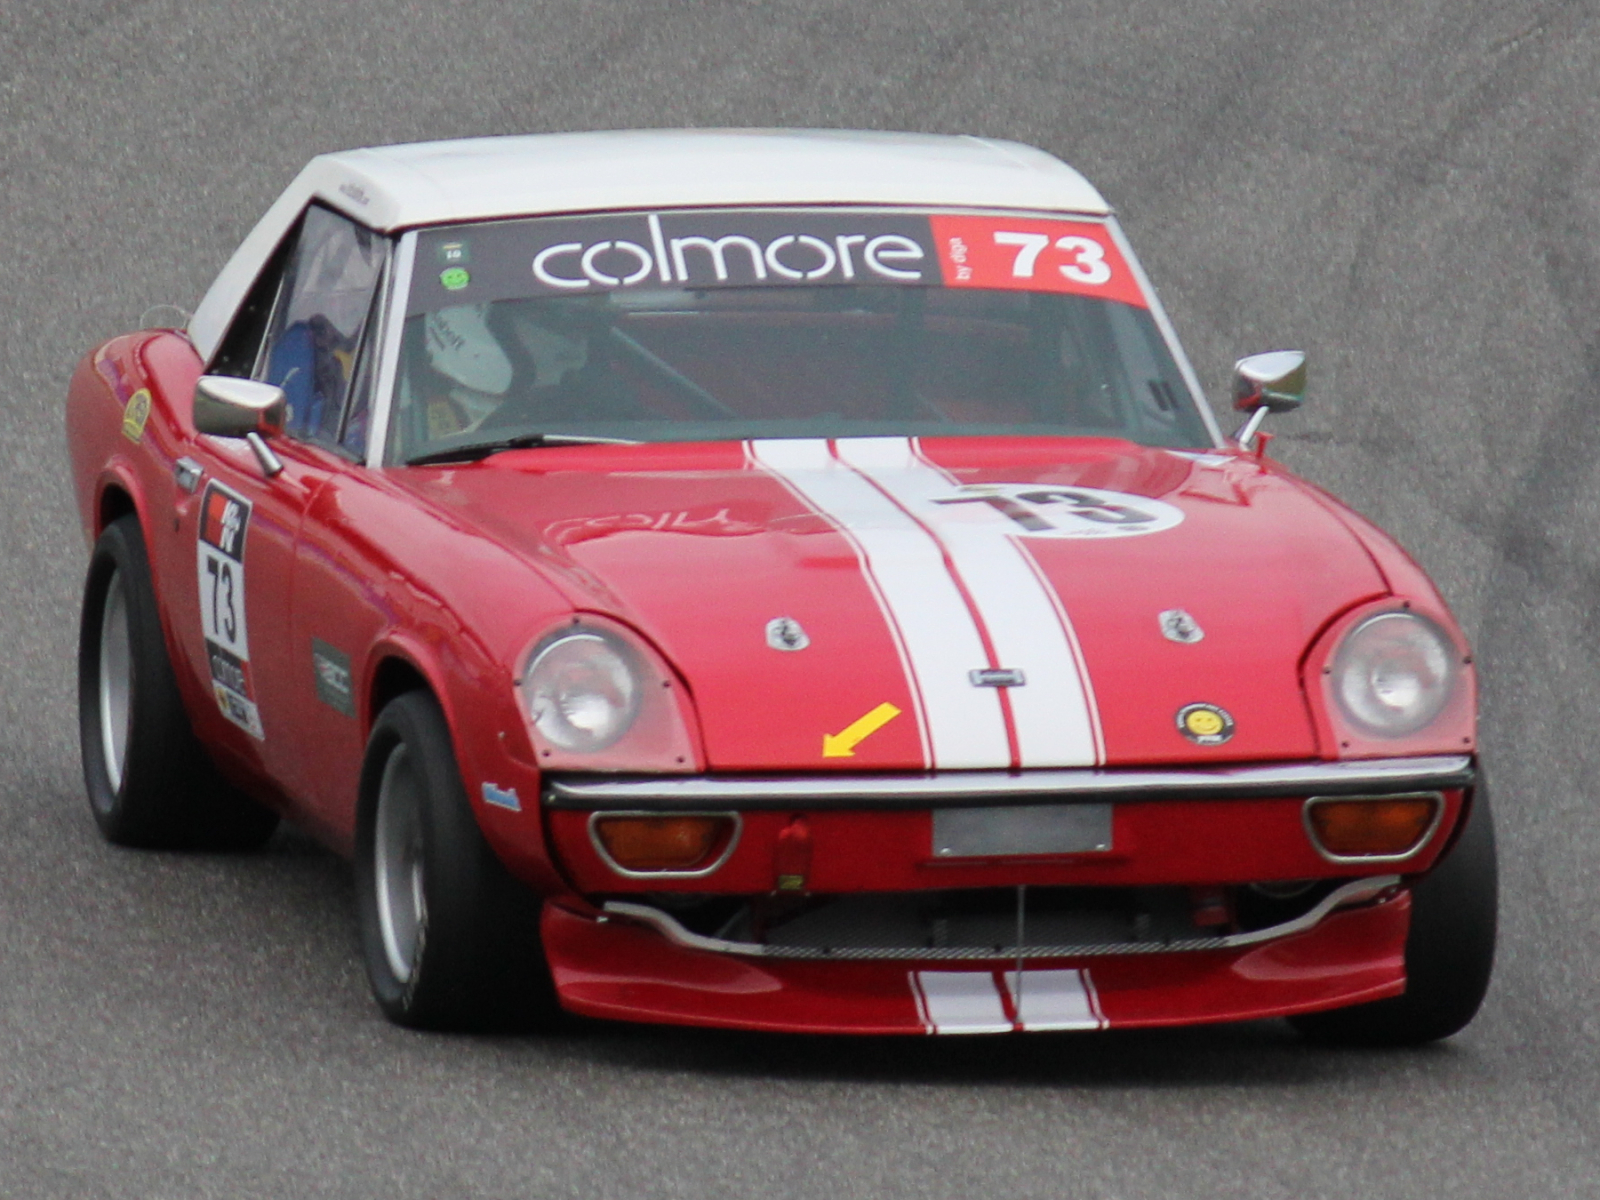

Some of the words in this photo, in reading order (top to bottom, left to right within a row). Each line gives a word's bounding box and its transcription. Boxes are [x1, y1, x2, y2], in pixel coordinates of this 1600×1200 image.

[532, 213, 925, 288] colmore
[993, 230, 1112, 286] 73
[927, 490, 1158, 532] 73
[206, 553, 237, 644] 73
